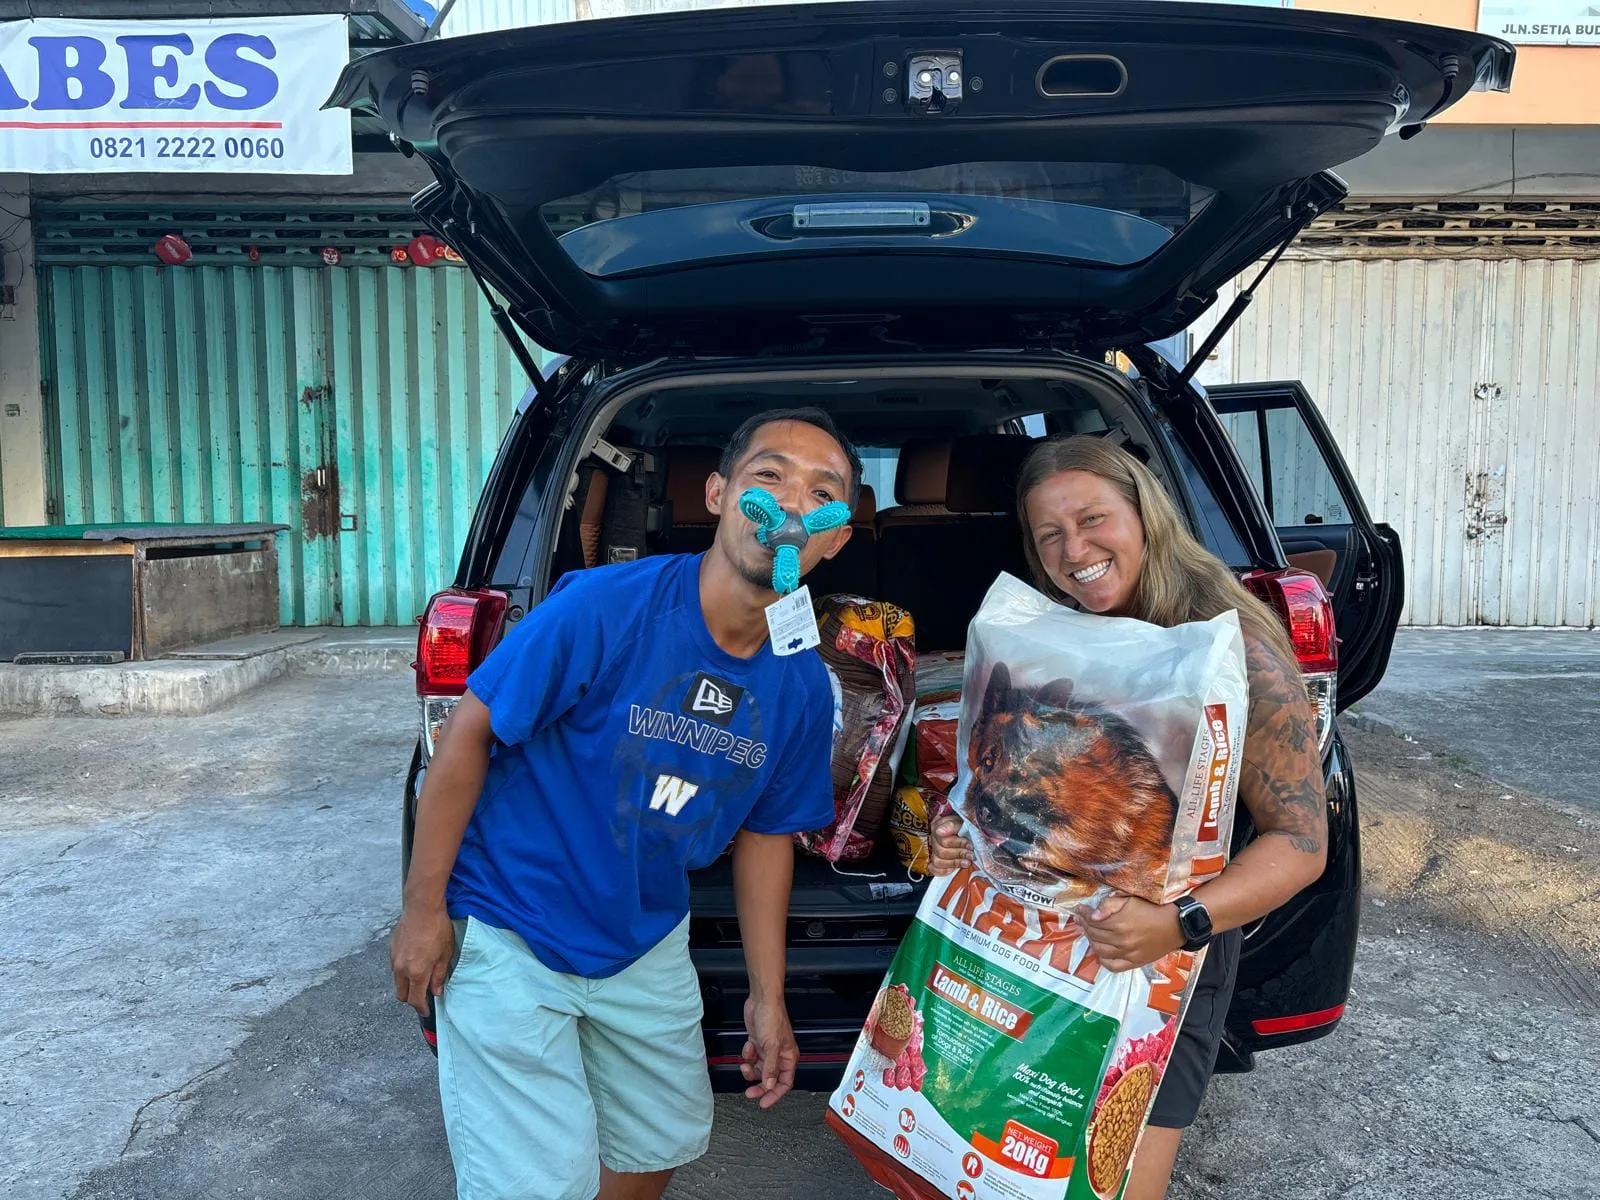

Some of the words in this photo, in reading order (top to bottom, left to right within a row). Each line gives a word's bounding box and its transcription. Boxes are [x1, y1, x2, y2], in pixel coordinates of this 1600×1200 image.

[1501, 24, 1571, 35] JLN.SETIA
[90, 137, 146, 158] 0821
[157, 137, 216, 158] 2222
[224, 137, 285, 158] 0060
[629, 704, 767, 768] WINNIPEG
[1211, 719, 1229, 761] Rice
[1214, 763, 1226, 777] &
[649, 774, 699, 817] W
[1187, 797, 1197, 819] ALL
[1192, 774, 1203, 797] LIFE
[1204, 780, 1222, 828] Lamb
[953, 955, 970, 969] ALL
[969, 962, 984, 978] LIFE
[985, 971, 1022, 996] STAGES
[992, 944, 1012, 959] DOG
[1013, 954, 1040, 973] FOOD
[932, 968, 970, 1003] Lamb
[968, 993, 980, 1011] &
[981, 996, 1018, 1030] Rice
[1012, 1071, 1029, 1084] 100%
[1017, 1063, 1039, 1079] Maxi
[1039, 1072, 1057, 1090] Dog
[1058, 1080, 1081, 1097] food
[1001, 1136, 1049, 1175] 20Kg
[1007, 1127, 1021, 1138] NET
[1023, 1134, 1053, 1153] WEIGHT
